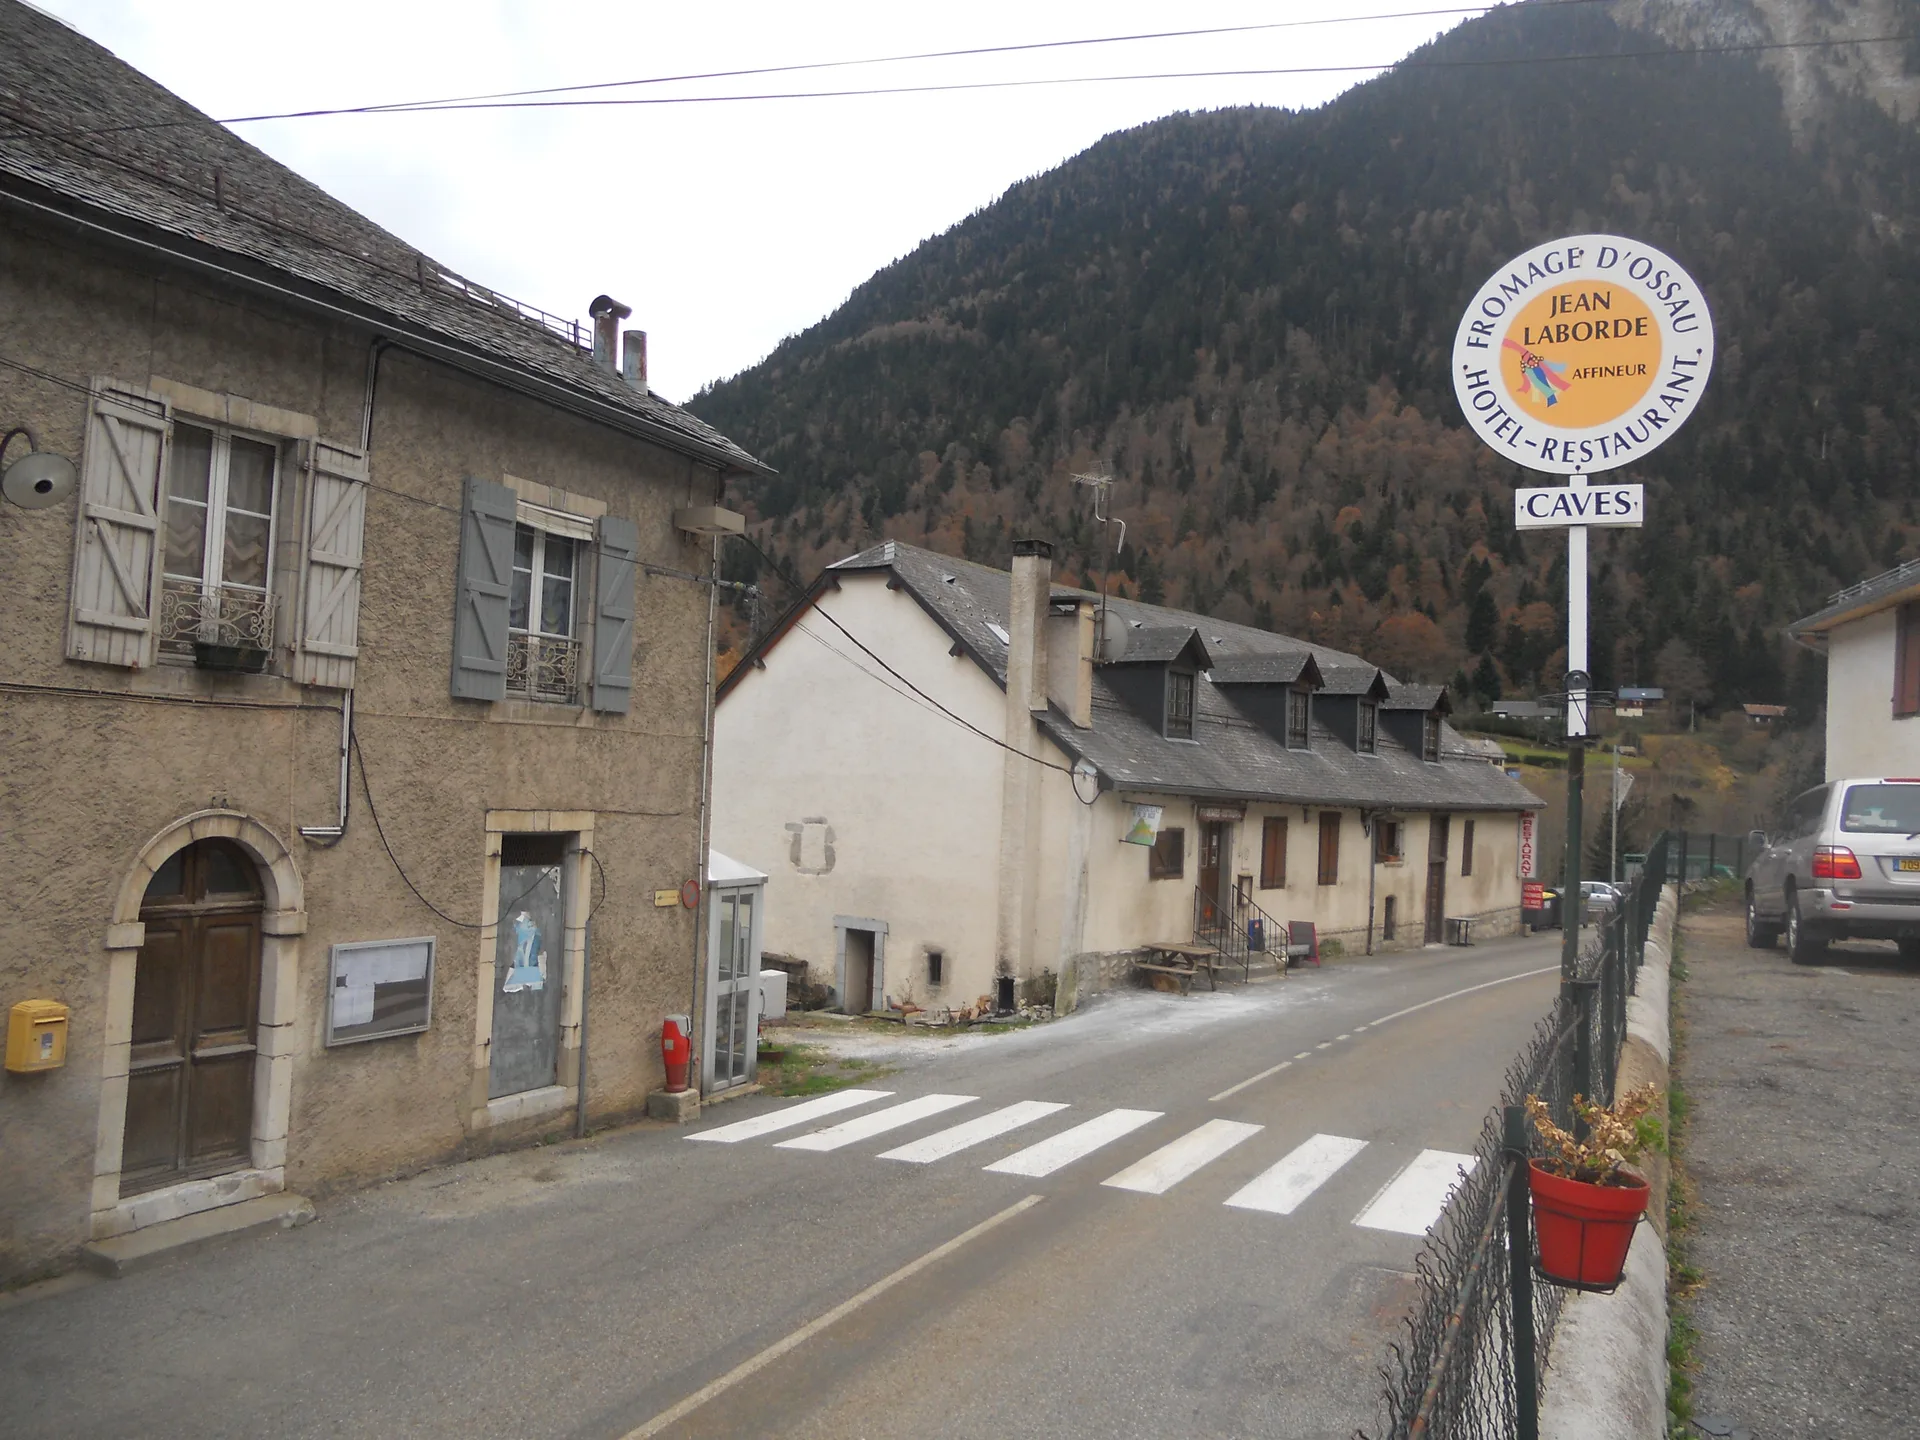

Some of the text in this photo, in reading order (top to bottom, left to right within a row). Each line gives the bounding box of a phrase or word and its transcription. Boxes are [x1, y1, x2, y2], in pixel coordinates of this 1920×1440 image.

[1466, 246, 1699, 349] FROMAGE D'OSSAU
[1549, 291, 1611, 318] JEAN
[1523, 317, 1648, 346] LABORDE
[1572, 363, 1647, 380] AFFINEUR
[1465, 355, 1699, 464] HOTEL-RESTAURANT
[1526, 490, 1631, 518] CAVES
[1521, 820, 1532, 877] RESTAURANT
